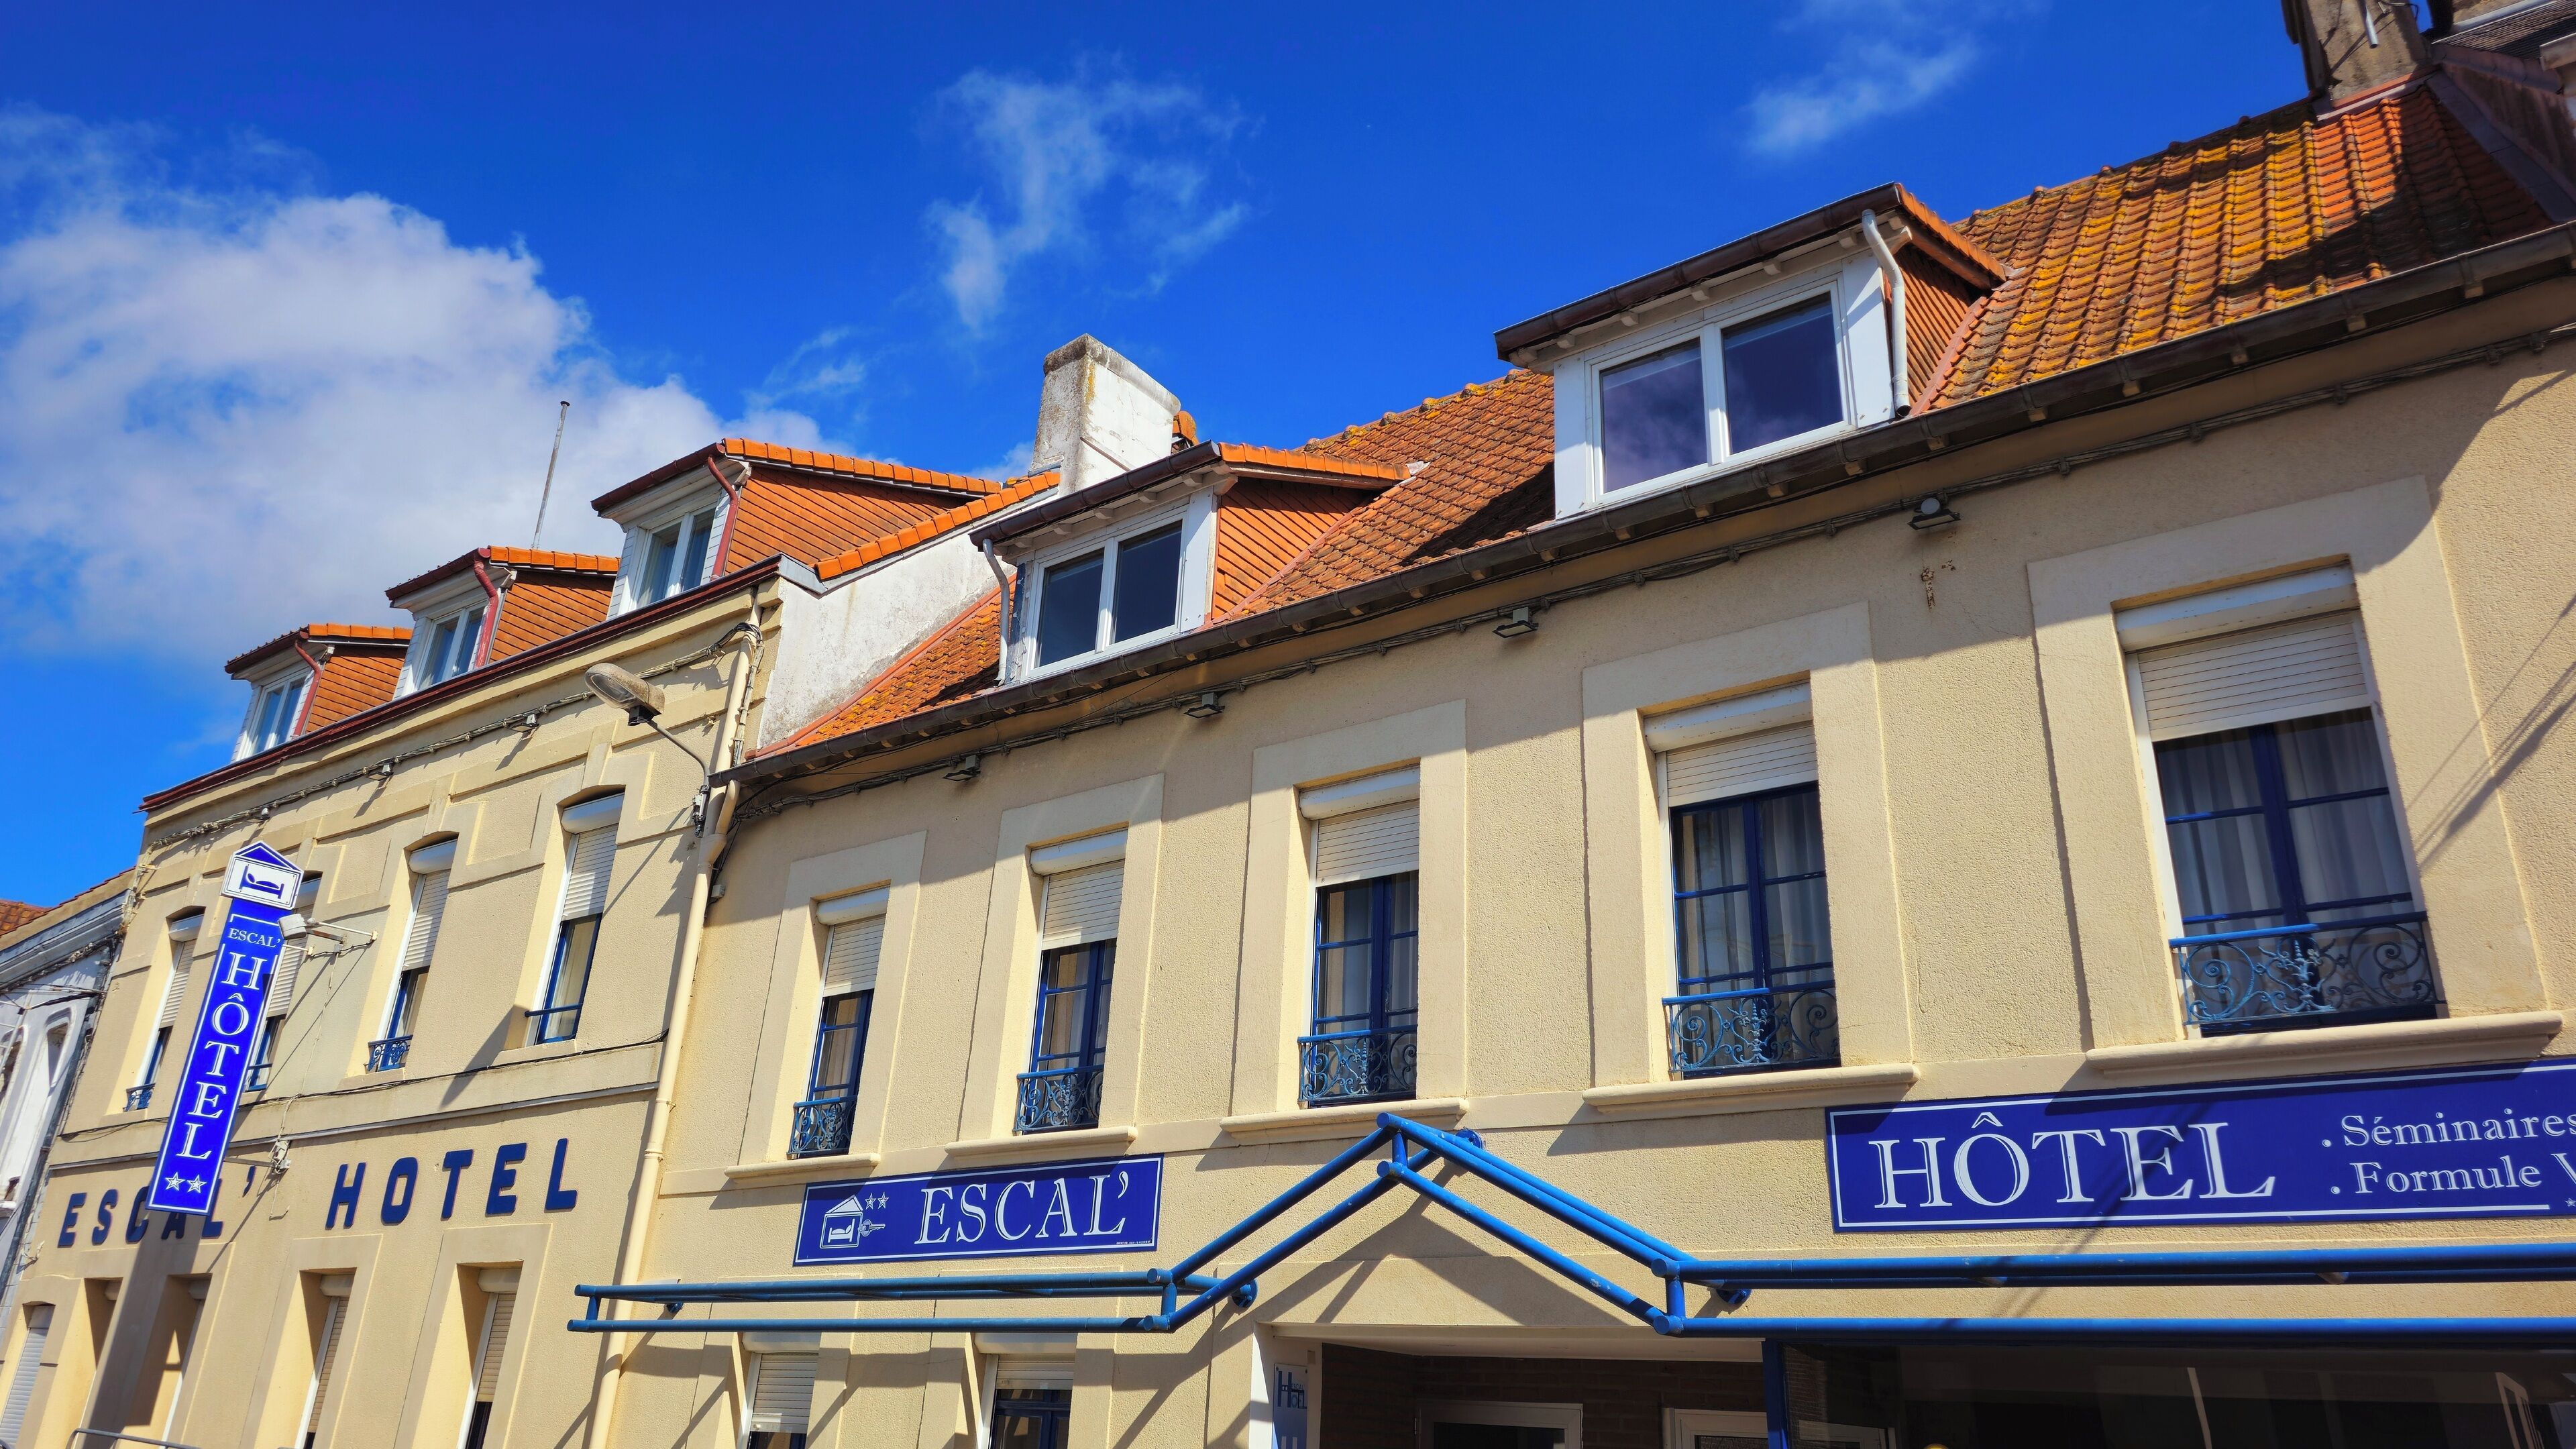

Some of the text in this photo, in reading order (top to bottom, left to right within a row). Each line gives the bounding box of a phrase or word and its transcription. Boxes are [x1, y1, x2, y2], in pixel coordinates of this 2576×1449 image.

[227, 928, 280, 947] ESCAL'
[176, 952, 267, 1160] HÔTEL
[1868, 1112, 2276, 1208] HÔTEL
[2341, 1108, 2576, 1146] Séminaires
[325, 1138, 578, 1230] HOTEL
[914, 1171, 1129, 1244] ESCAL'
[2349, 1155, 2542, 1194] Formule
